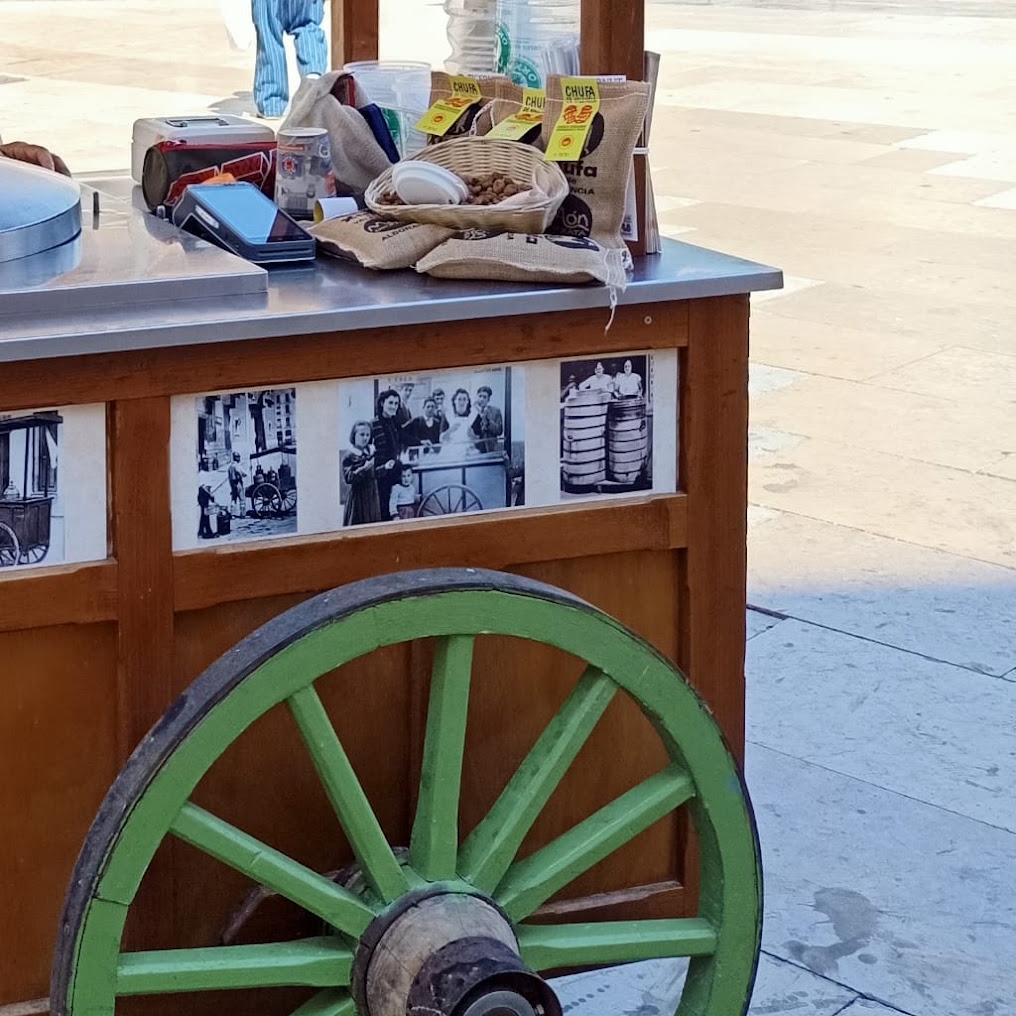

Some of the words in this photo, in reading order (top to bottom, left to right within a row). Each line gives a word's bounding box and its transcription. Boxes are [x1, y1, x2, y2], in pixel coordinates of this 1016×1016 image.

[453, 81, 477, 95] CHUFA
[565, 85, 595, 99] CHUFA
[525, 96, 546, 108] CHU
[563, 161, 597, 177] ufa
